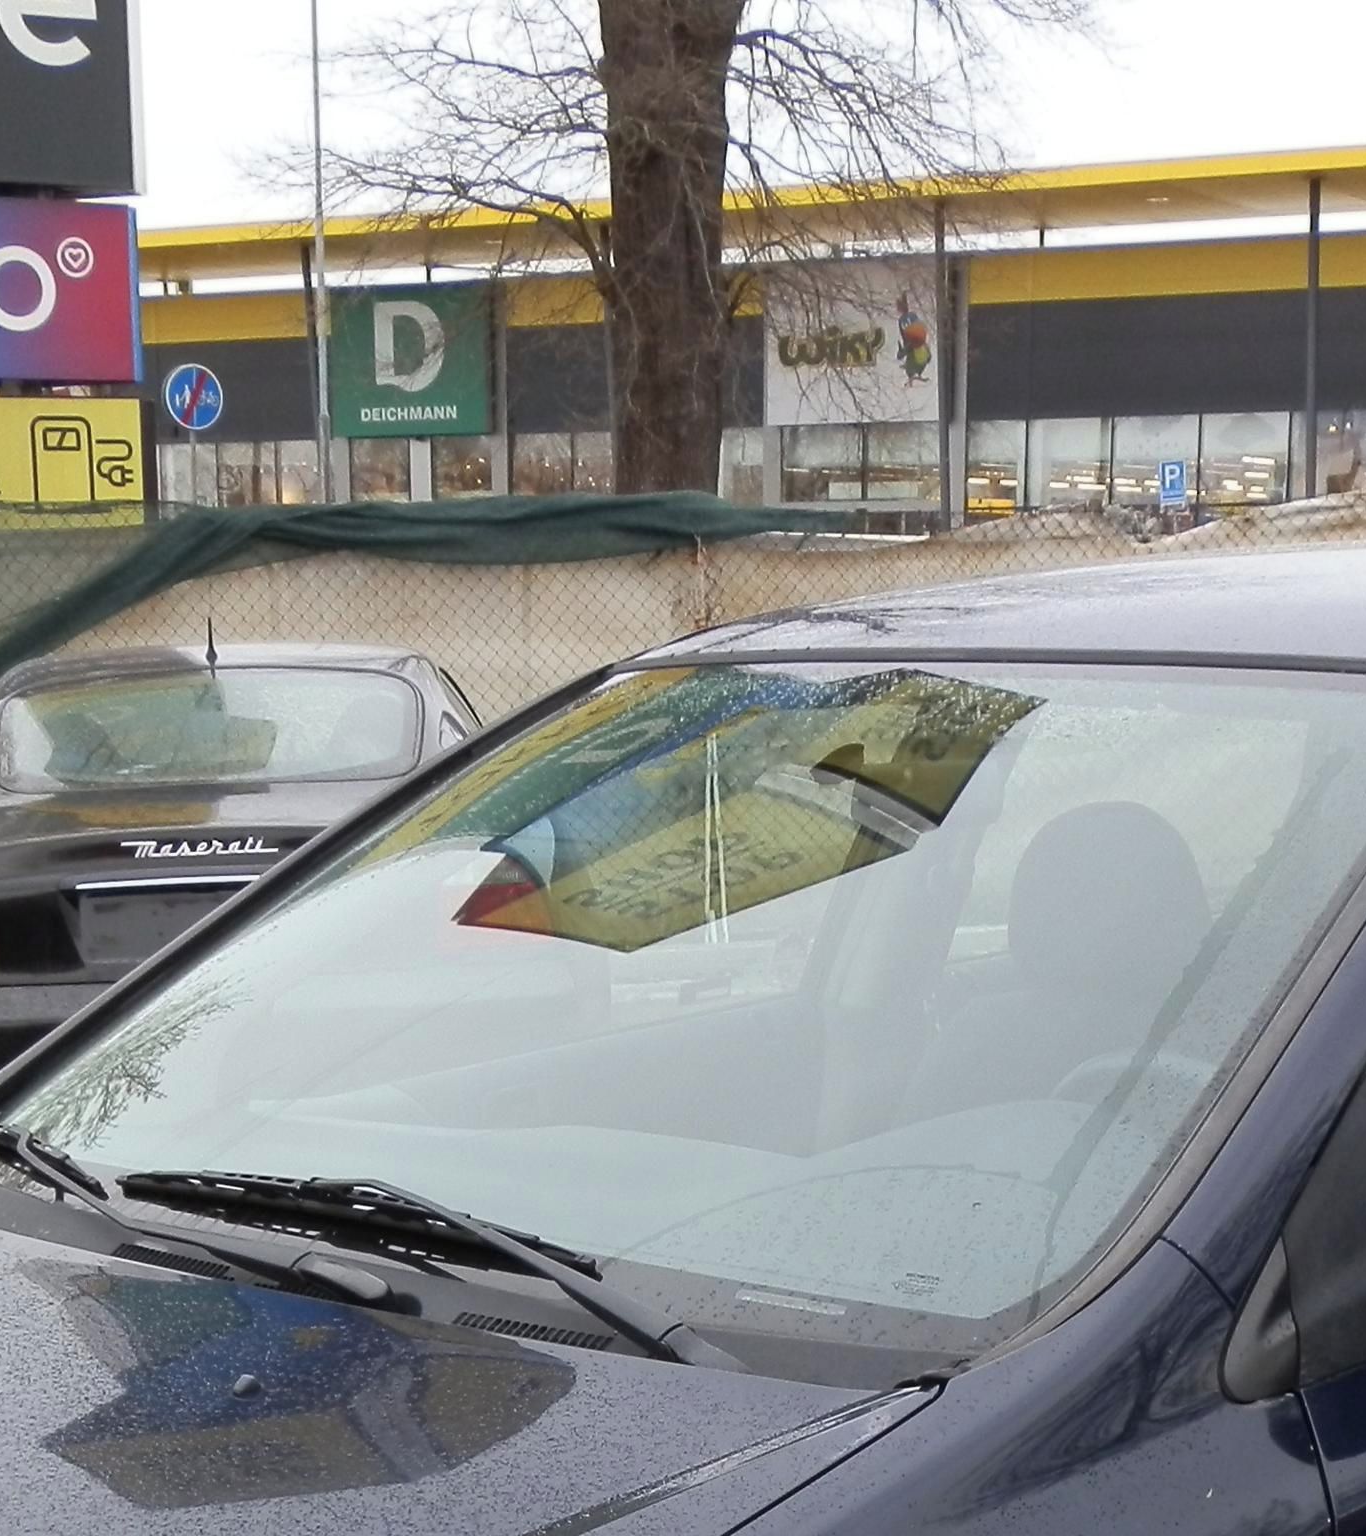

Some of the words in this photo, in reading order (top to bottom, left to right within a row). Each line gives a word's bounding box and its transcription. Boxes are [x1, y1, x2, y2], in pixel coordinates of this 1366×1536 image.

[374, 300, 445, 392] D
[361, 405, 457, 421] DEICHMANN
[1165, 464, 1181, 489] P
[120, 836, 279, 859] Maserati
